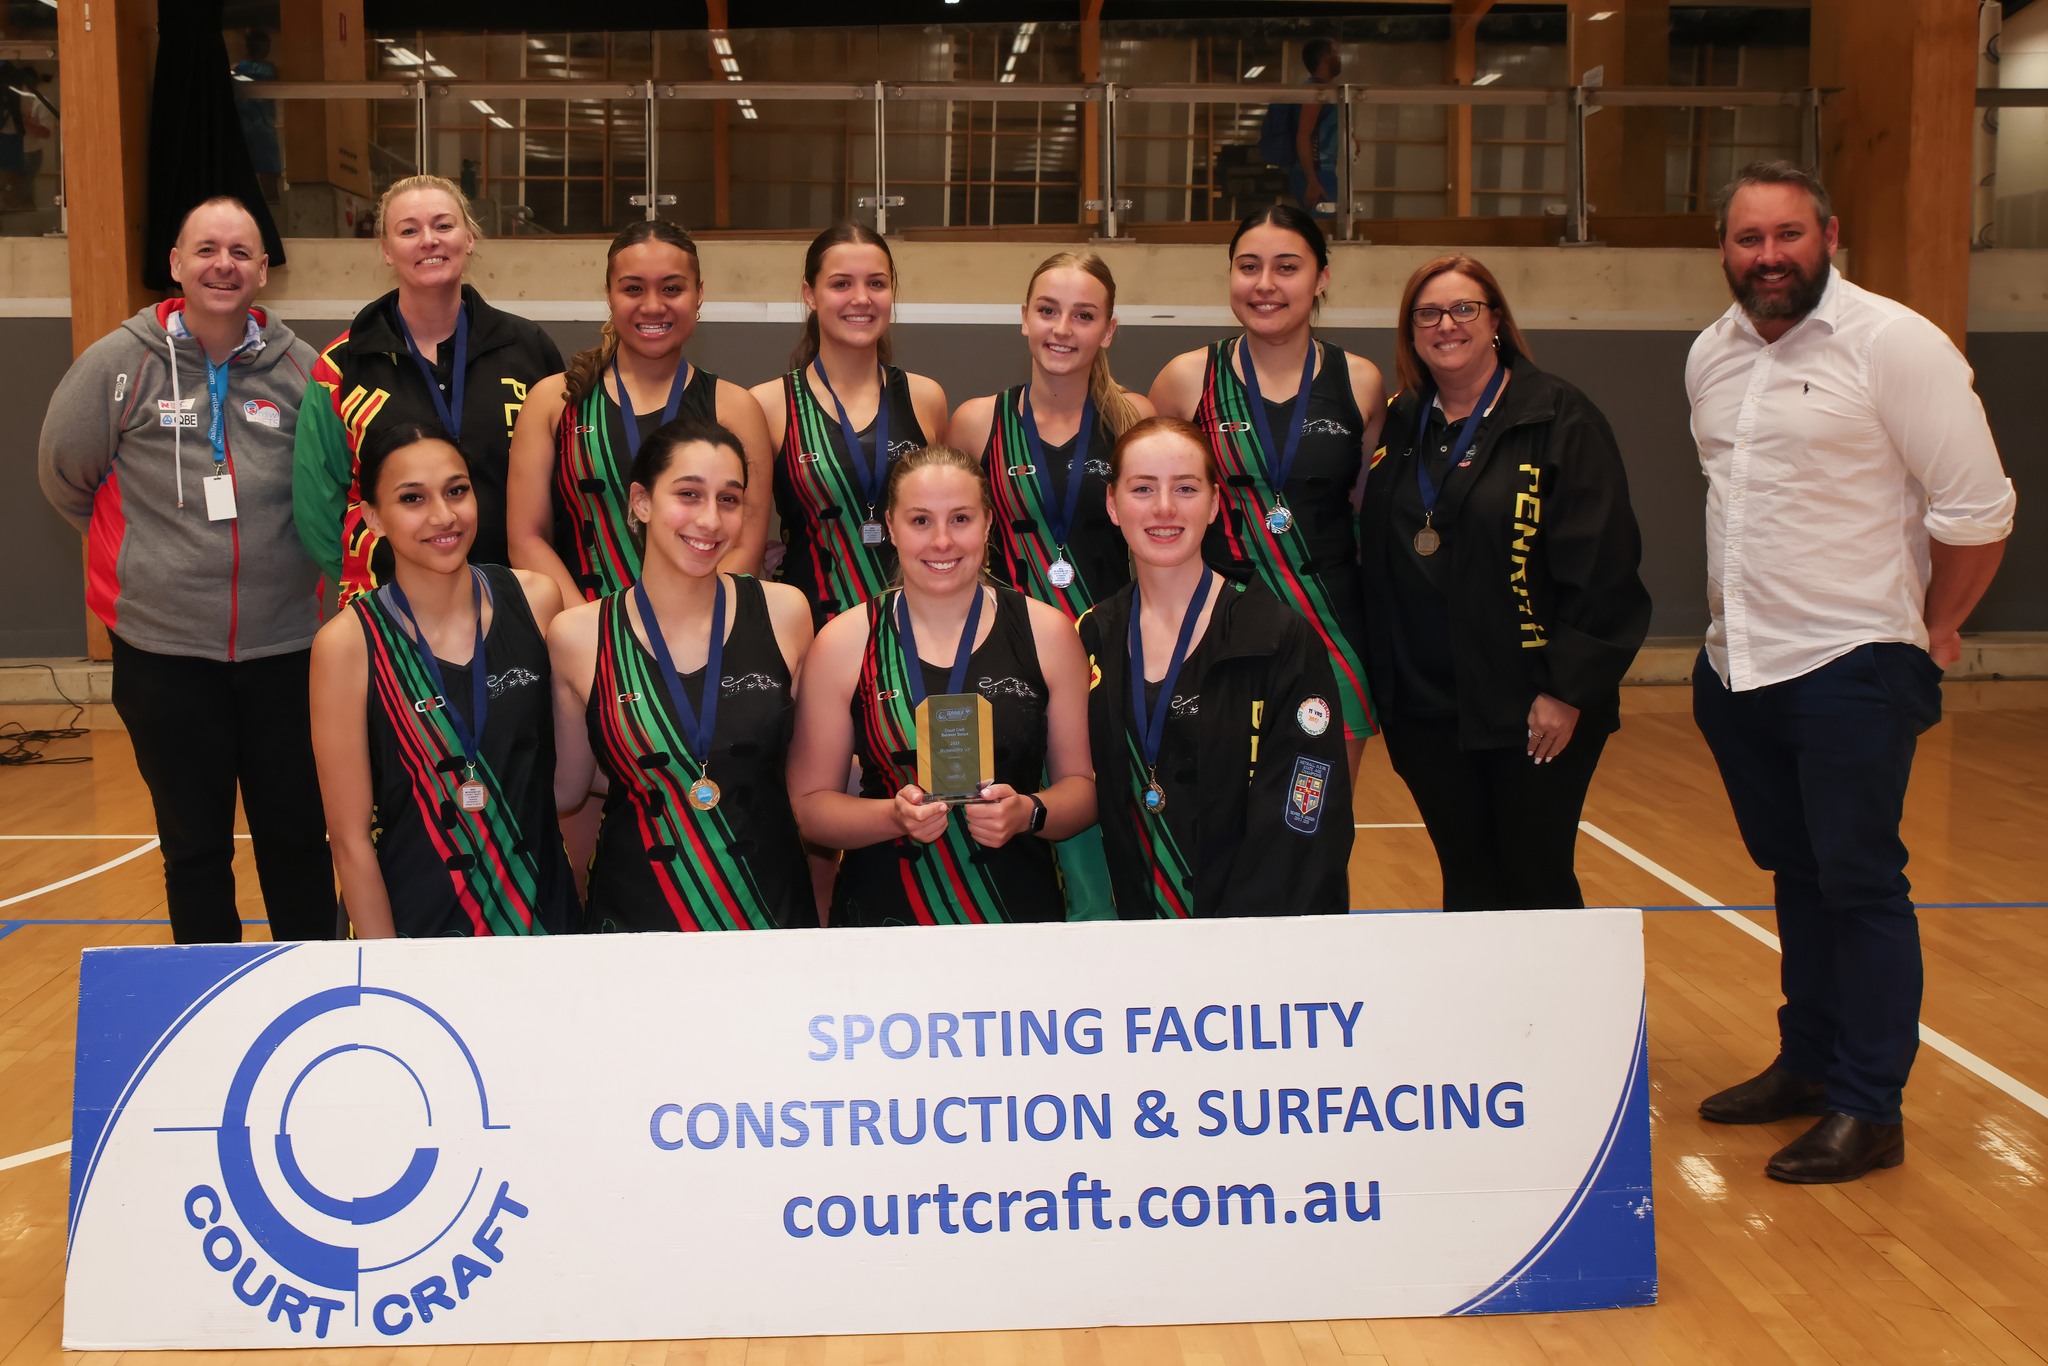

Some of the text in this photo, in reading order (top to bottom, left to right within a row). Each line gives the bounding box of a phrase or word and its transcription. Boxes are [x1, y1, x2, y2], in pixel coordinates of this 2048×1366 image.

[809, 1002, 1363, 1061] SPORTING FACILITY
[651, 1083, 1525, 1151] CONSTRUCTION & SURFACING
[784, 1172, 1381, 1239] courtcraft.com.au
[184, 1181, 529, 1338] COURT CRAFT
